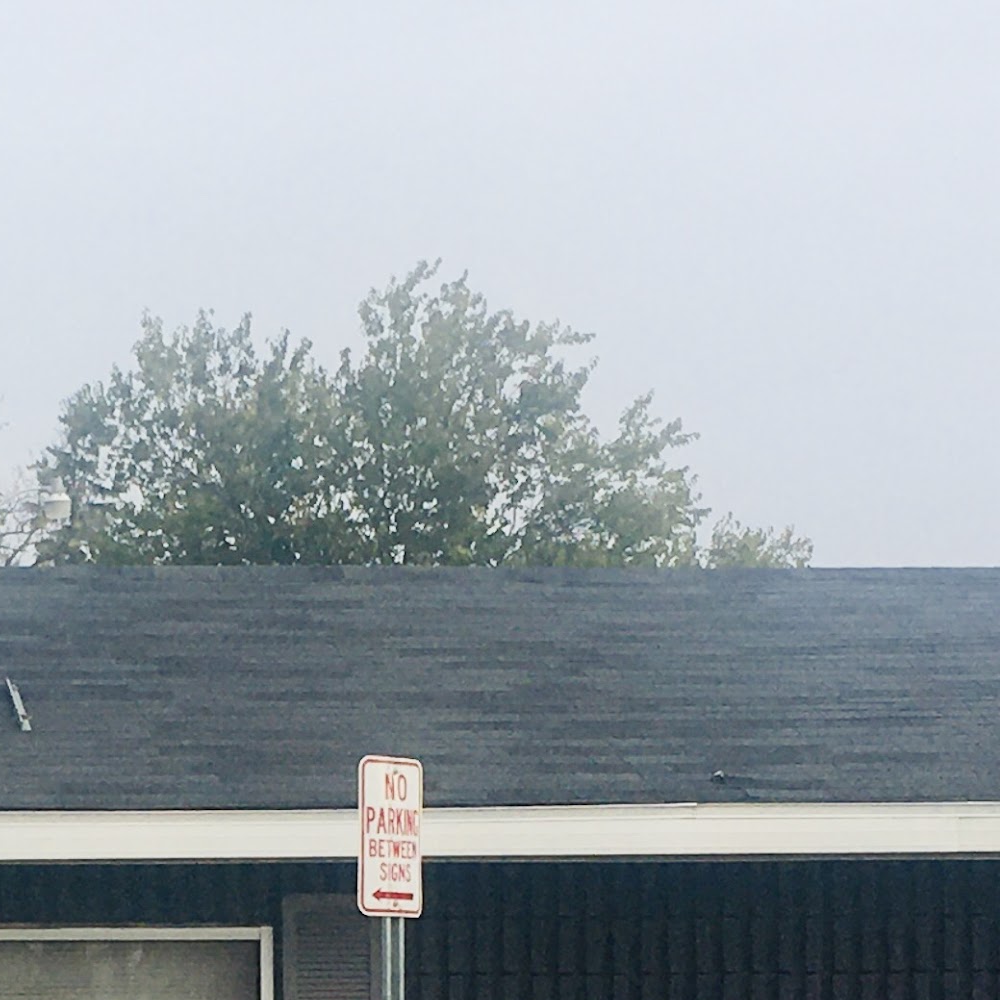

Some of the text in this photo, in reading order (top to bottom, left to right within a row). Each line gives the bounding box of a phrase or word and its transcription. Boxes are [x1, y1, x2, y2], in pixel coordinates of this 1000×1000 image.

[385, 774, 407, 800] NO
[366, 807, 418, 835] PARKING
[368, 839, 416, 859] BETWEEN
[379, 863, 411, 882] SIGNS
